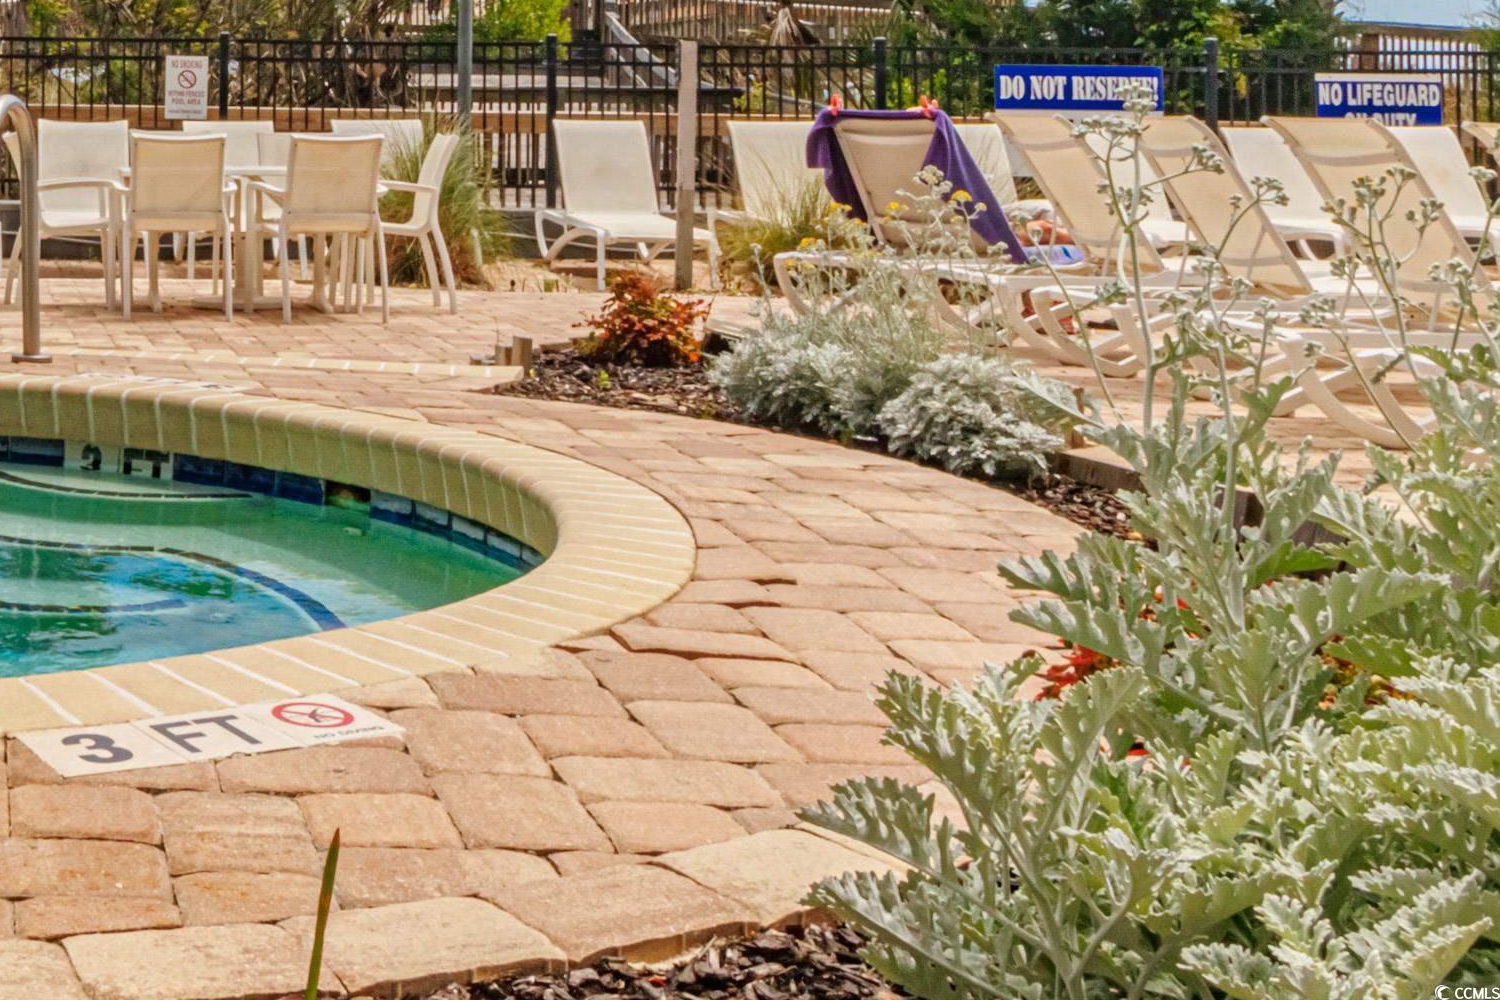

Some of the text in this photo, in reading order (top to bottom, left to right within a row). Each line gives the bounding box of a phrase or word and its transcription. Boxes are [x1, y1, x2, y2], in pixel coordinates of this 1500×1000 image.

[1000, 75, 1025, 100] DO
[1030, 75, 1067, 100] NOT
[1319, 83, 1440, 107] NO LIFEGUARD
[61, 714, 262, 764] 3 FT
